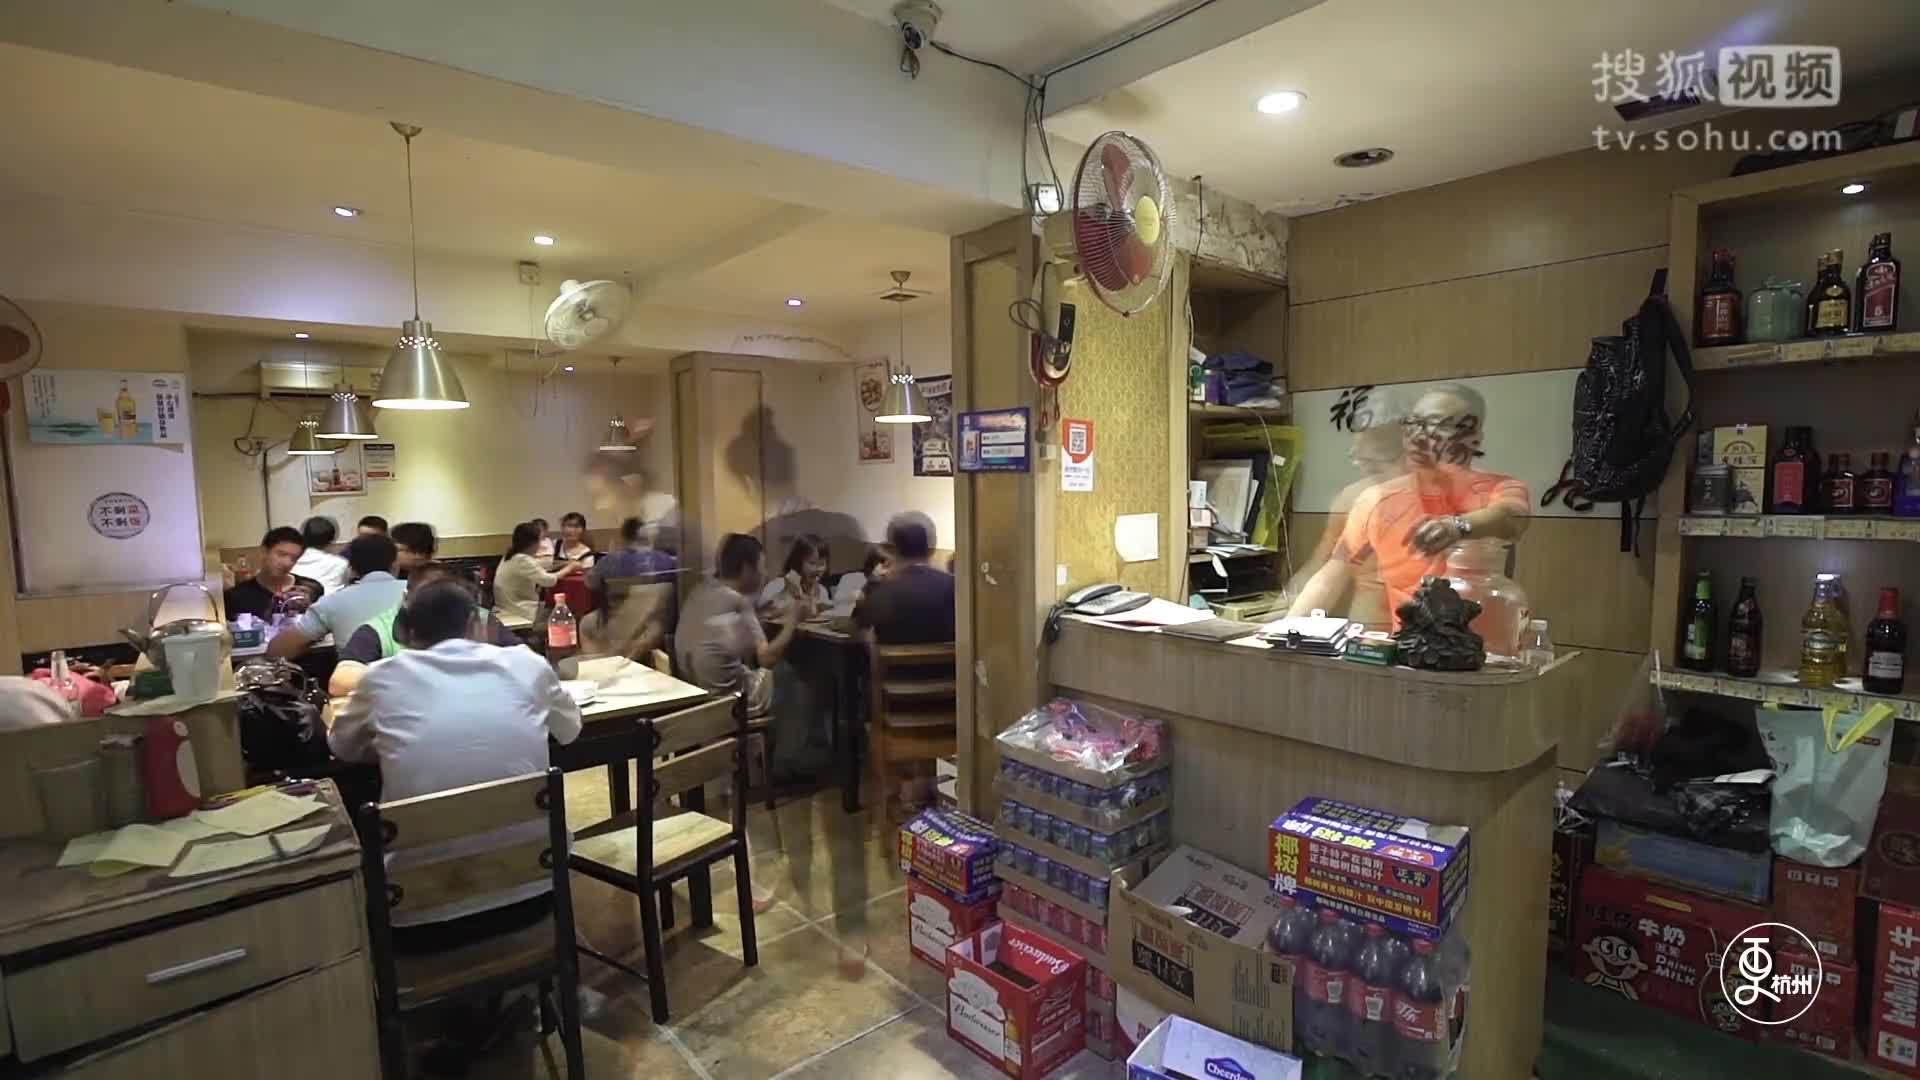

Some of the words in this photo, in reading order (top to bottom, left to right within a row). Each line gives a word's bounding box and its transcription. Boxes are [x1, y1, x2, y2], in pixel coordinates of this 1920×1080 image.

[1273, 832, 1299, 896] 椰树牌
[1008, 937, 1071, 976] Budweiser
